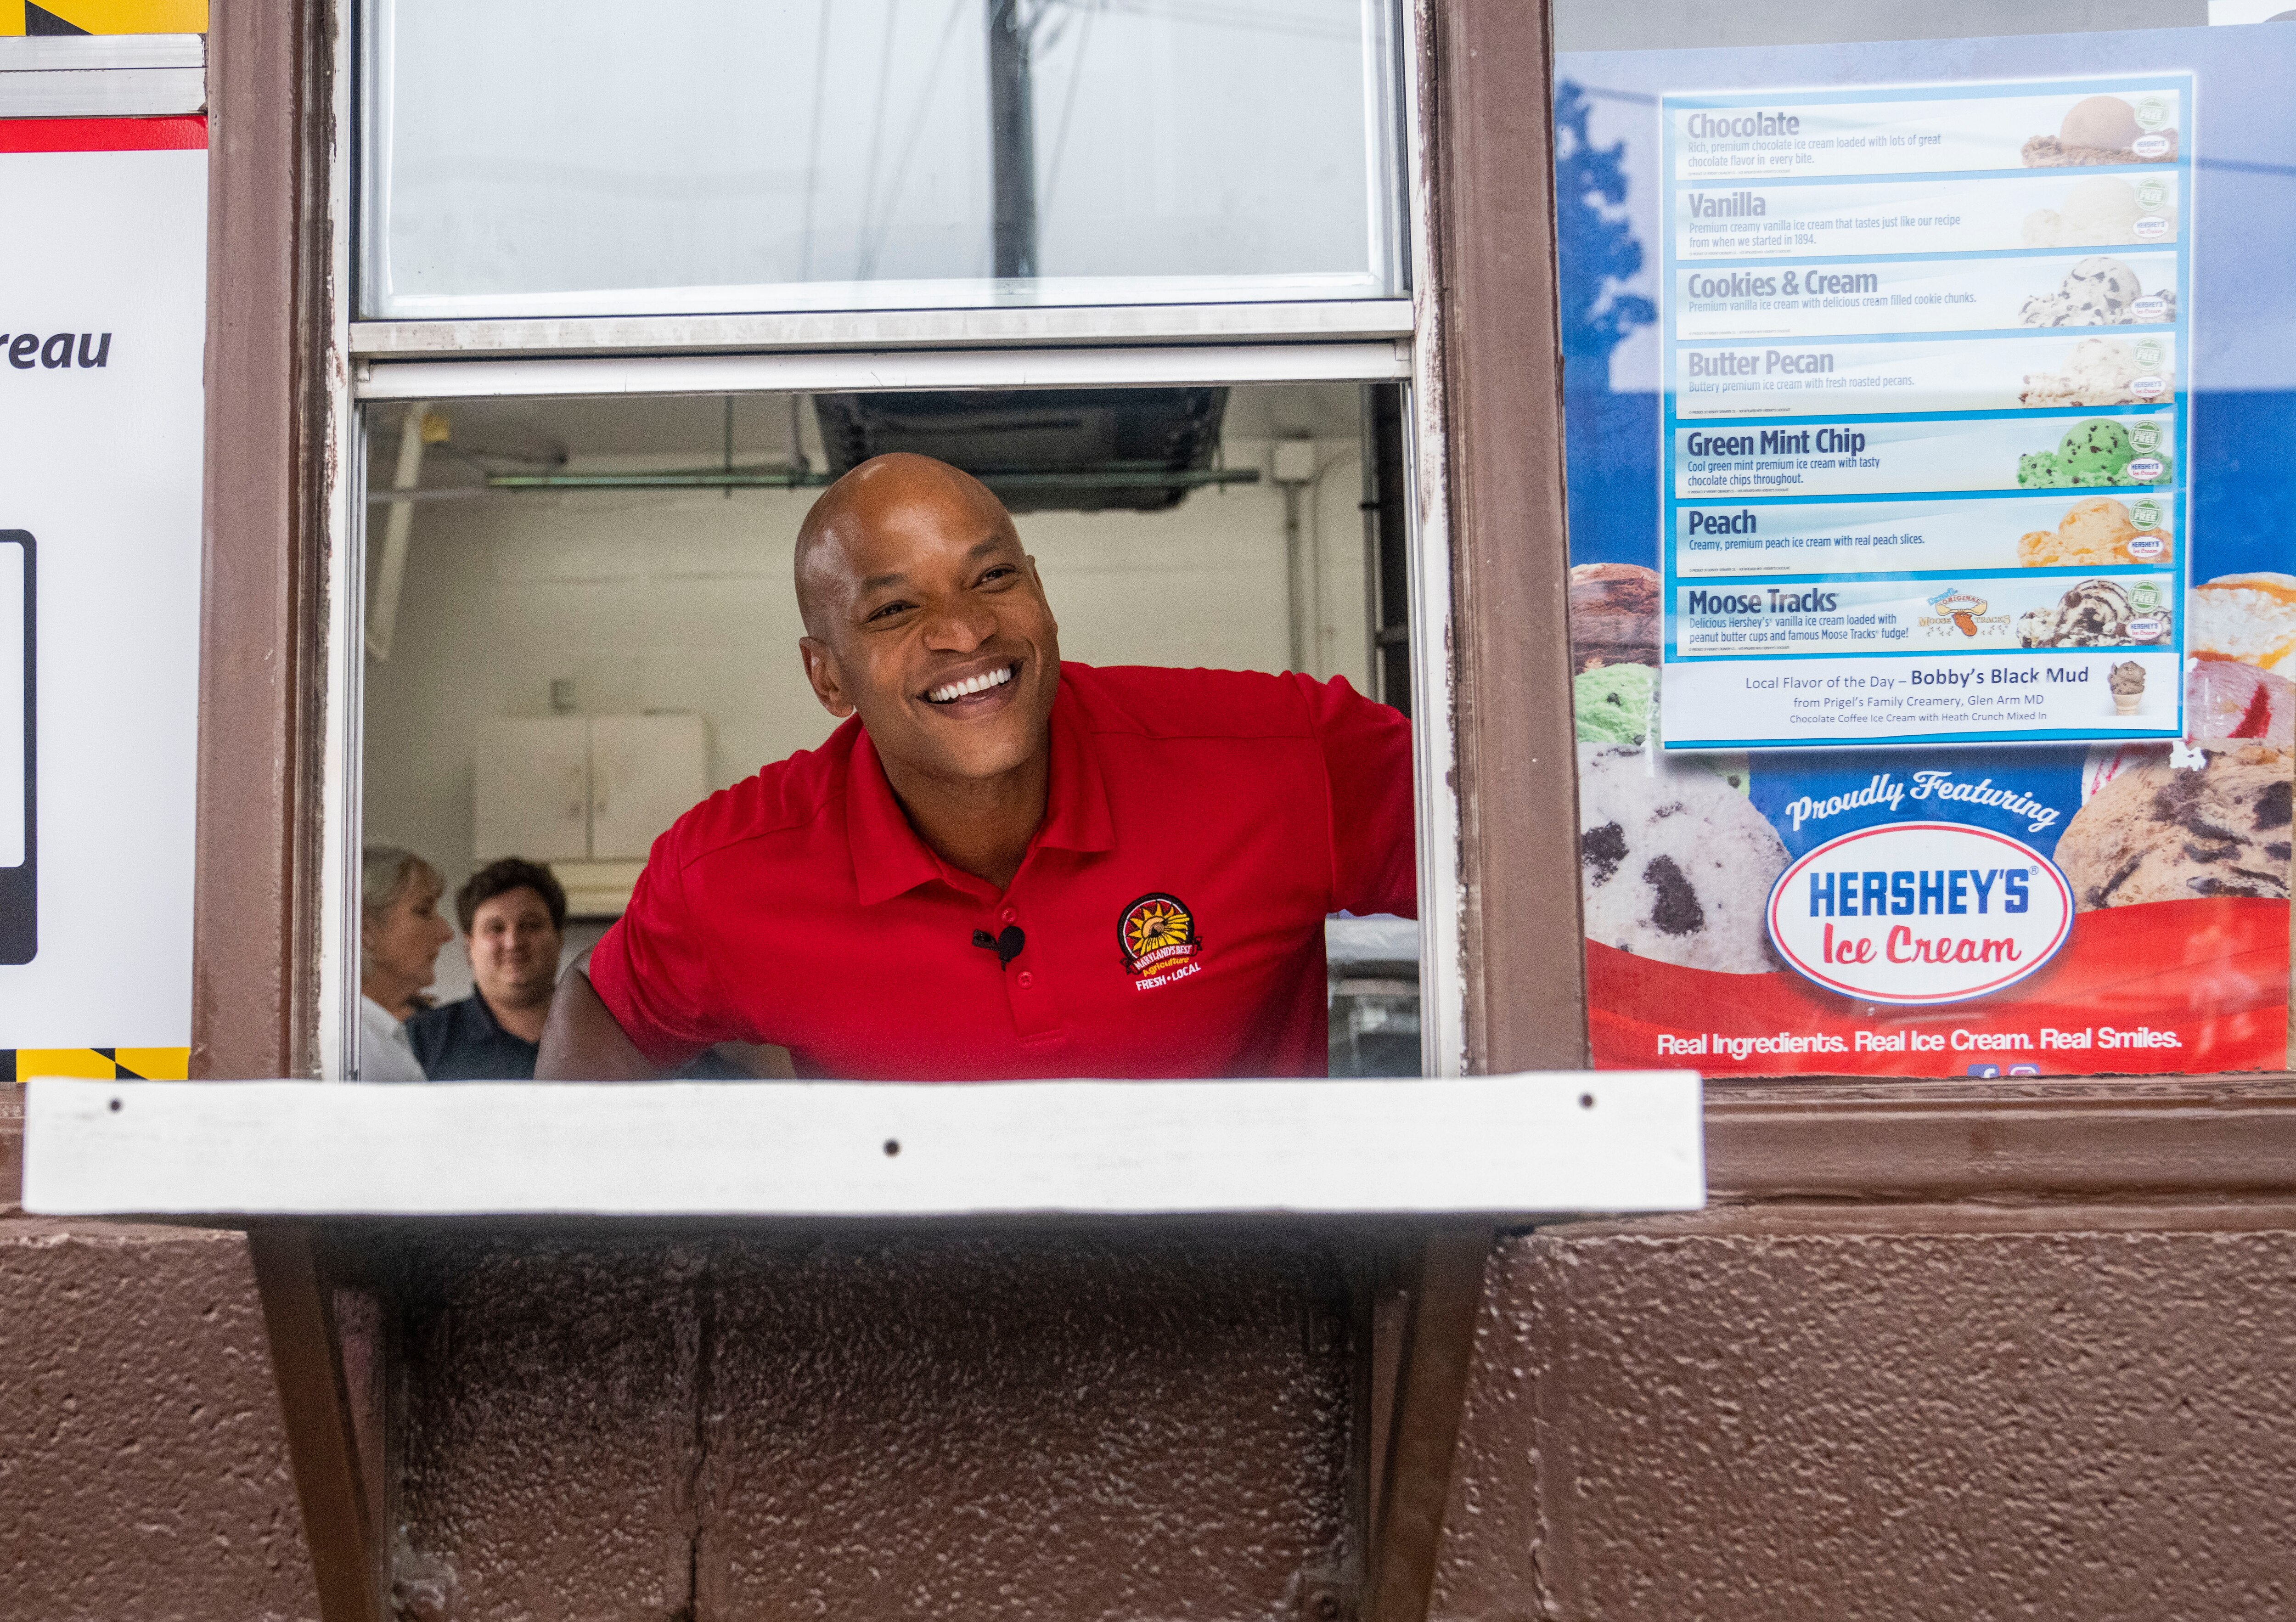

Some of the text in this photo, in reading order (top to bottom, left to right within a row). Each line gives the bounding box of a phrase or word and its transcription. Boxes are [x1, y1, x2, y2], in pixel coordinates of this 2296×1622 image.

[1688, 111, 1801, 139] Chocolate
[1688, 133, 1943, 154] Rich, premium chocolate ice cream loaded with lots of great
[1688, 152, 1815, 168] chocolate flavor in every bite.
[1688, 191, 1766, 218] Vanilla
[1689, 214, 1961, 234] Premium creamy vanilla ice cream that tastes just like our recipe
[1689, 233, 1817, 248] from when we started in 1894.
[1688, 270, 1878, 298] Cookies & Cream
[1688, 292, 1977, 312] Premium vanilla ice cream with delicious cream filled cookie chunks.
[1688, 350, 1834, 377] Butter Pecan
[1688, 375, 1915, 394] Buttery premium ice cream with fresh roasted pecans.
[1687, 428, 1866, 457] Green Mint Chip
[1687, 456, 1880, 473] Cool green mint premium ice cream with tasty
[1688, 473, 1804, 487] chocolate chips throughout.
[1689, 509, 1756, 535] Peach
[1689, 533, 1925, 551] Creamy, premium peach ice cream with real peach slices.
[1689, 590, 1762, 615] Moose
[1690, 617, 1727, 629] Delicious
[1775, 615, 1803, 627] vanilla
[1805, 615, 1817, 626] ice
[1818, 617, 1845, 626] cream
[1846, 614, 1876, 625] loaded
[1877, 613, 1897, 625] with
[1689, 632, 1719, 644] peanut
[1721, 631, 1747, 642] butter
[1749, 632, 1768, 643] cups
[1769, 630, 1786, 641] and
[1788, 630, 1820, 641] famous
[1821, 629, 1848, 640] Moose
[1881, 627, 1909, 639] fudge!
[1746, 677, 1778, 689] Local
[1784, 677, 1823, 688] Flavor
[1827, 676, 1840, 688] of
[1844, 676, 1866, 687] the
[1870, 676, 1895, 689] Day
[1911, 668, 1985, 688] Bobby's
[1991, 667, 2040, 684] Black
[2046, 666, 2089, 683] Mud
[1793, 694, 2044, 710] from Prigel's Family Creamery, Glen Arm MD
[1790, 715, 1835, 724] Chocolate
[1837, 714, 1868, 723] Coffee
[1870, 714, 1884, 722] Ice
[1885, 714, 1916, 722] Cream
[1918, 713, 1939, 721] with
[1941, 712, 1969, 721] Heath
[1971, 712, 2004, 721] Crunch
[2007, 711, 2036, 721] Mixed
[1785, 770, 2060, 832] Proudly Featuring
[1823, 922, 2021, 964] Ice Cream
[1133, 945, 1192, 970] MARYLAND'S BEST
[1142, 957, 1189, 977] Agriculture
[1135, 962, 1201, 991] FRESH LOCAL
[1657, 1026, 2182, 1059] Real Ingredients. Real Ice Cream. Real Smiles.
